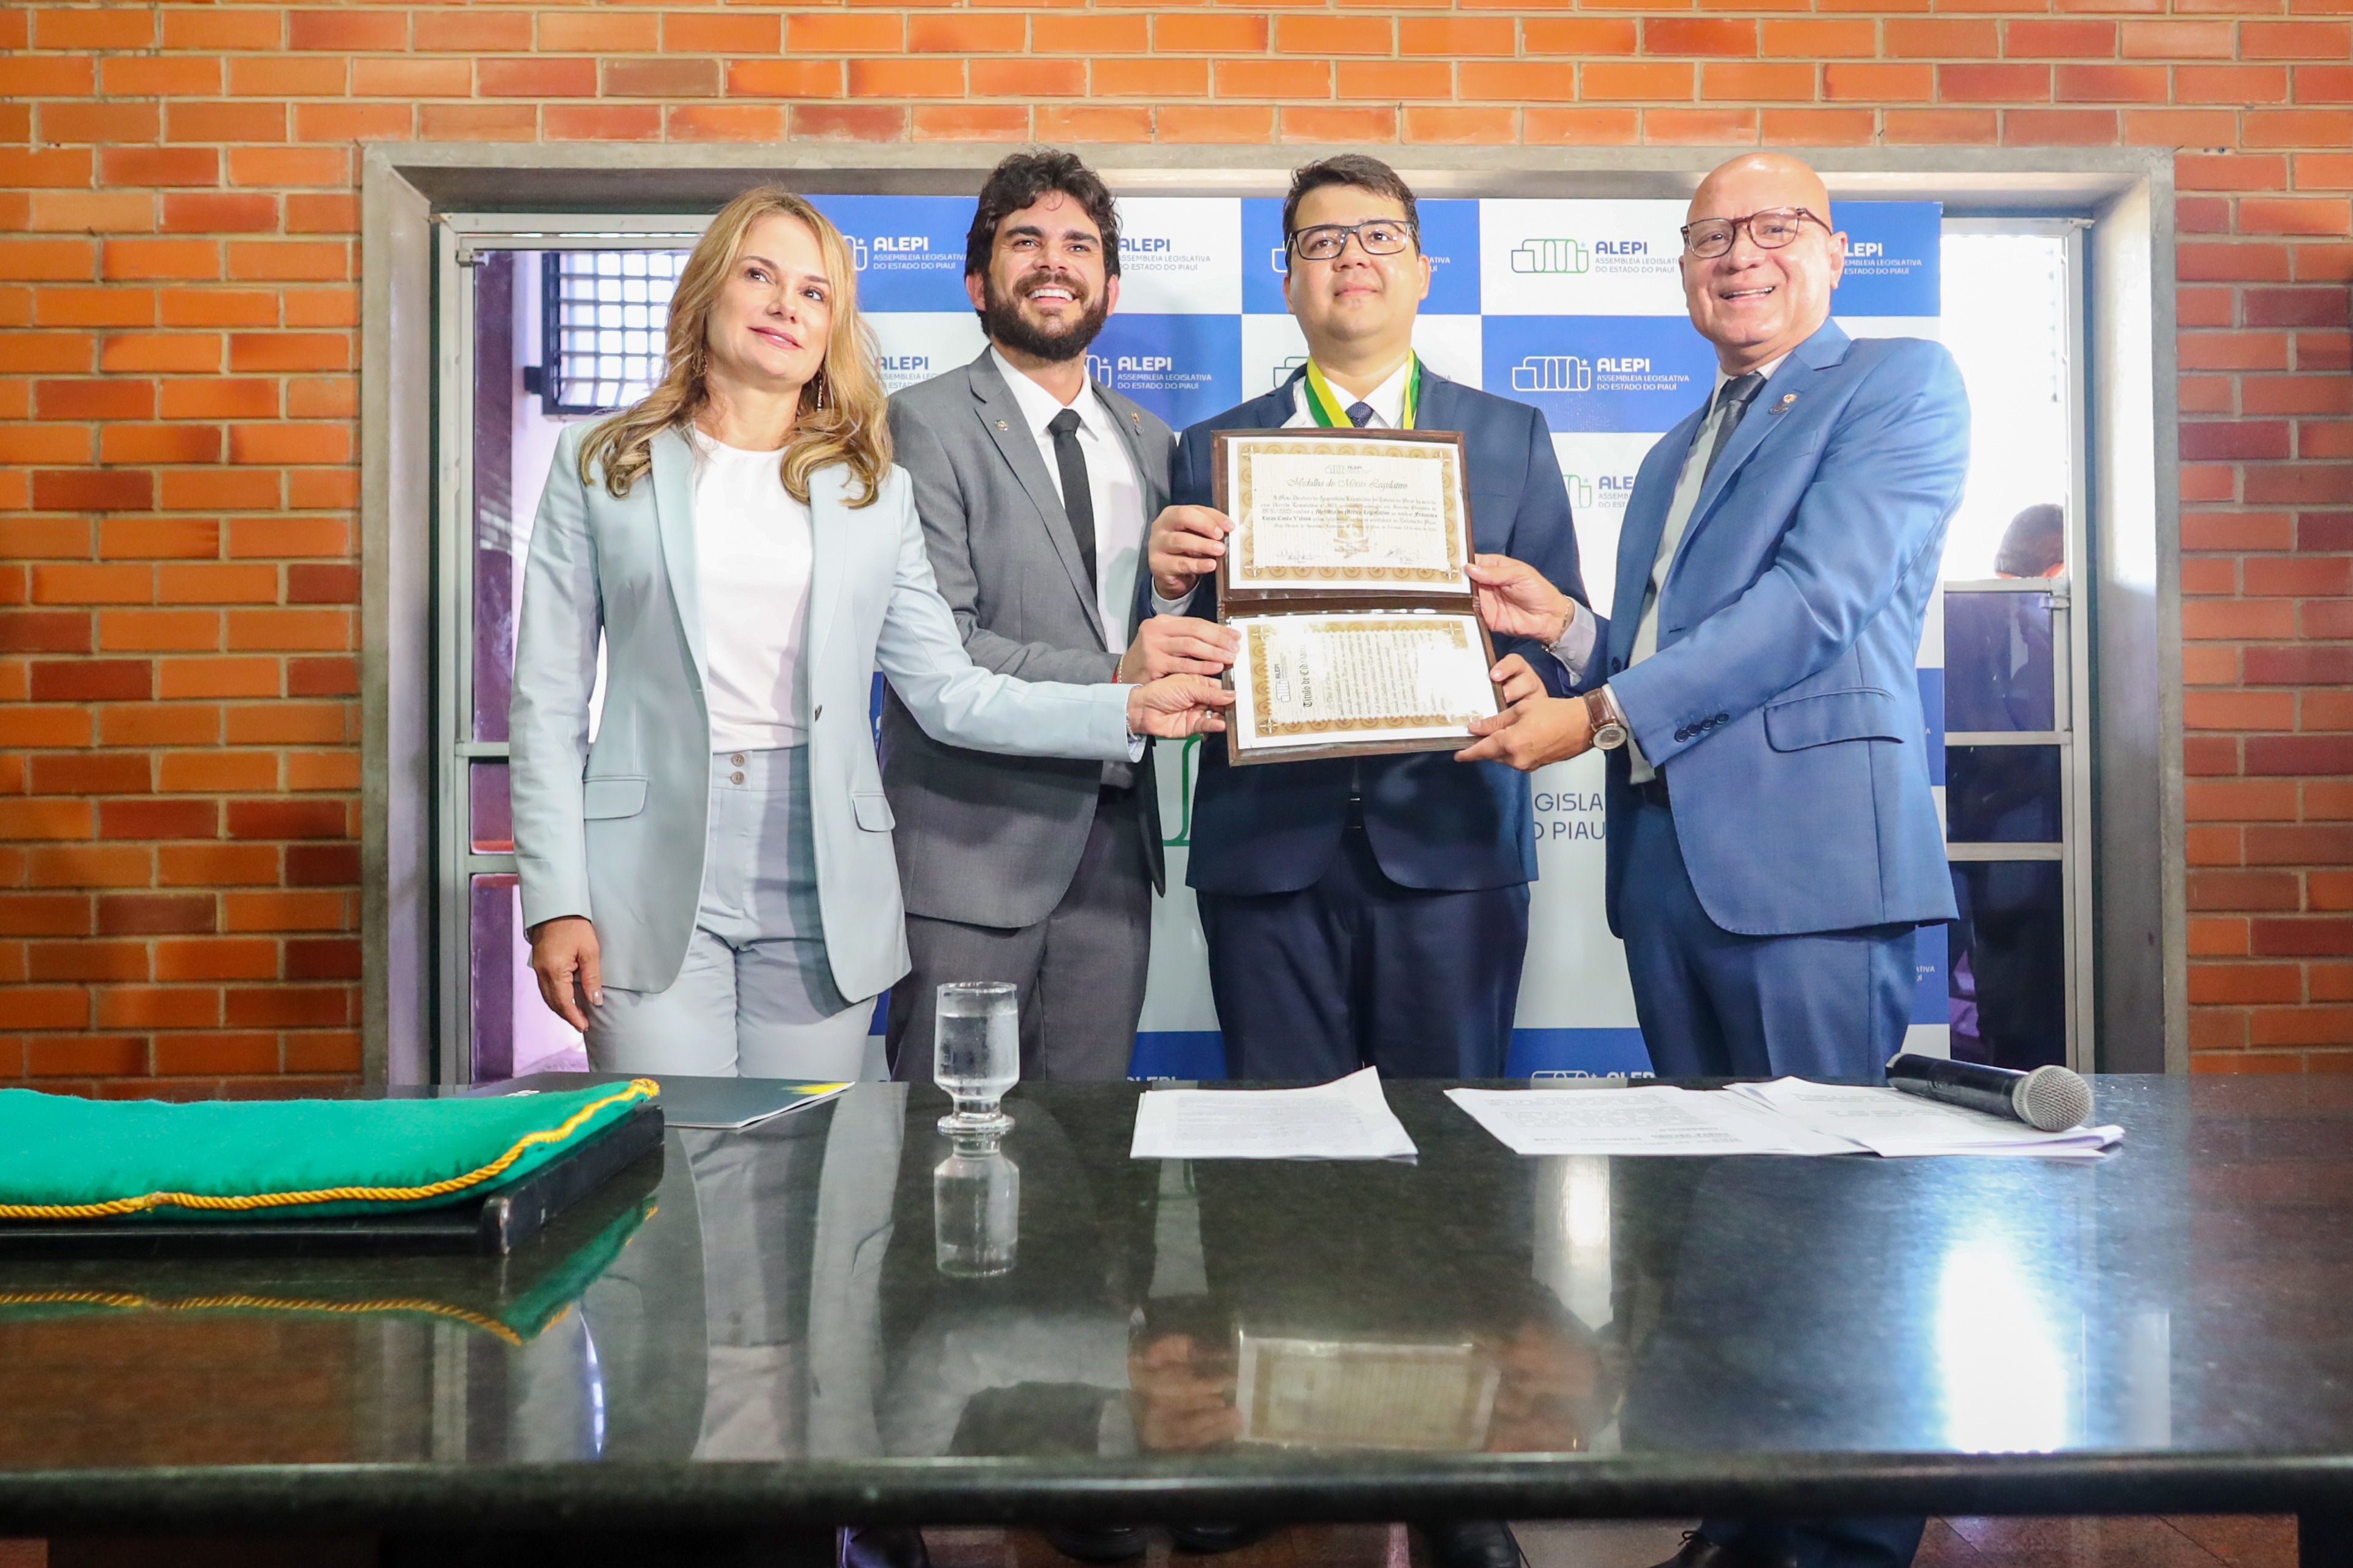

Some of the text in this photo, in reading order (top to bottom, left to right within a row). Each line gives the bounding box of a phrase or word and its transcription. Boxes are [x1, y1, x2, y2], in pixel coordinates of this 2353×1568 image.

[873, 237, 929, 251] ALEPI
[1118, 238, 1170, 252] ALEPI
[1596, 241, 1647, 255] ALEPI
[1846, 242, 1883, 256] LEPI
[876, 357, 929, 370] ALEPI
[1118, 356, 1172, 371] ALEPI
[1597, 358, 1650, 372] ALEPI
[1599, 476, 1633, 490] ALE
[1553, 822, 1606, 840] PIAU
